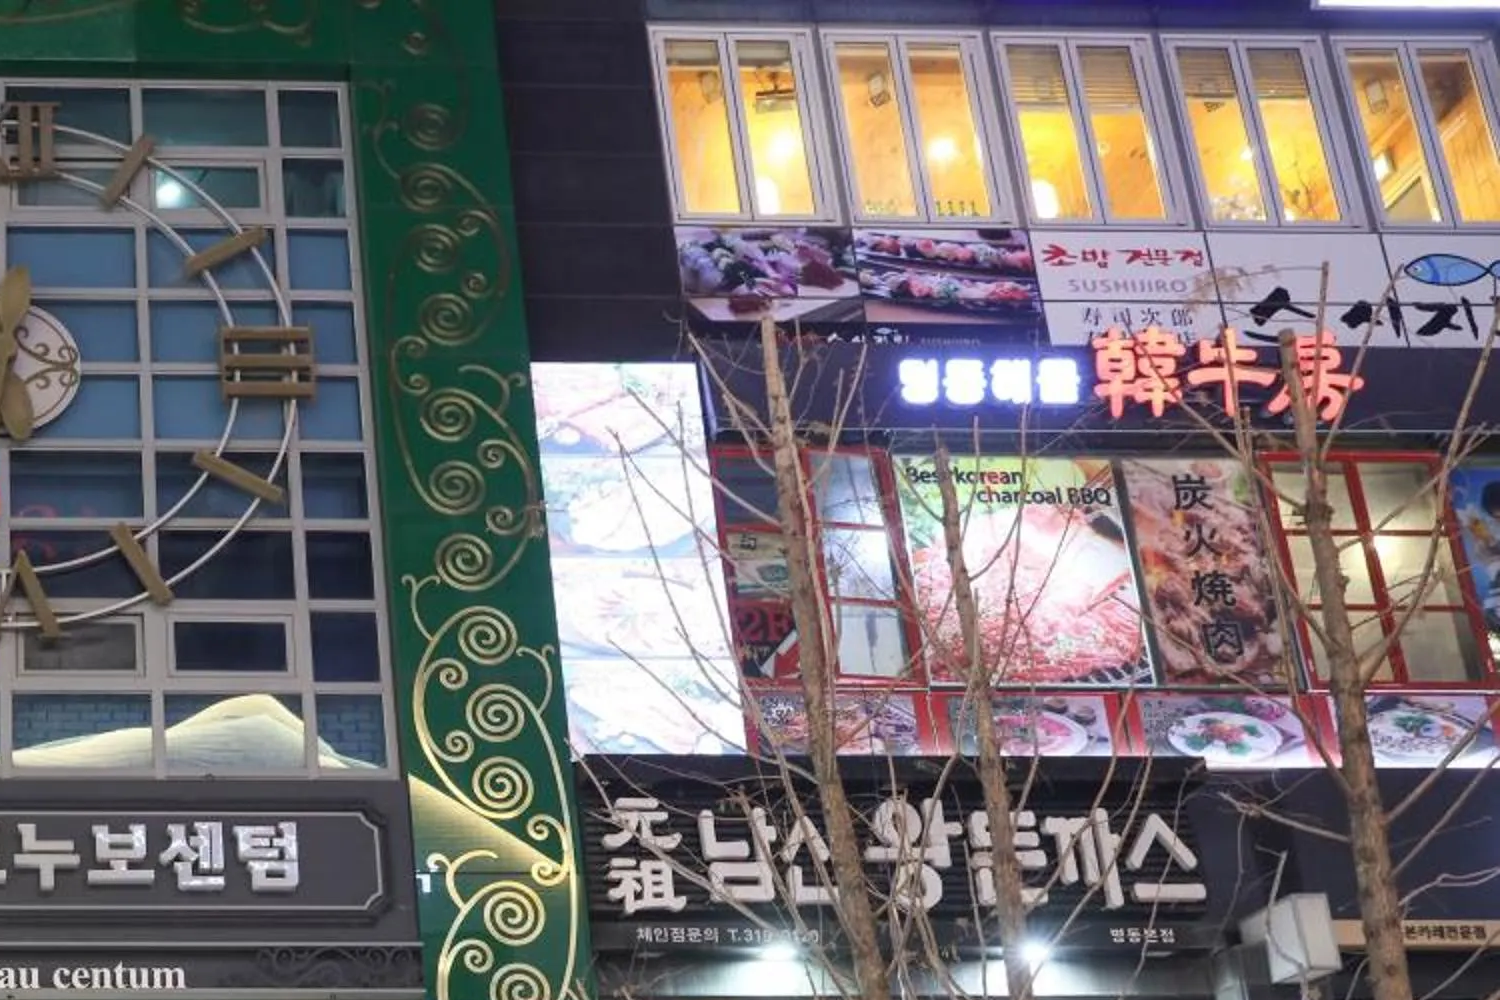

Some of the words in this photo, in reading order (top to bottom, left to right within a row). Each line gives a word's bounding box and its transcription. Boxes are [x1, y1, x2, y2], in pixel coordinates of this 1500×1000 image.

[1041, 244, 1109, 269] 초밥
[1125, 249, 1204, 268] 전문점
[1069, 278, 1188, 294] SUSHIJIRO
[1242, 286, 1500, 344] 스시지
[1089, 326, 1364, 421] 韓牛房
[905, 465, 956, 484] Bes
[977, 487, 1061, 505] charcoal
[1067, 488, 1113, 506] BBQ
[602, 797, 688, 914] 元祖
[1405, 925, 1488, 940] 본카레전문점
[53, 962, 186, 990] centum
